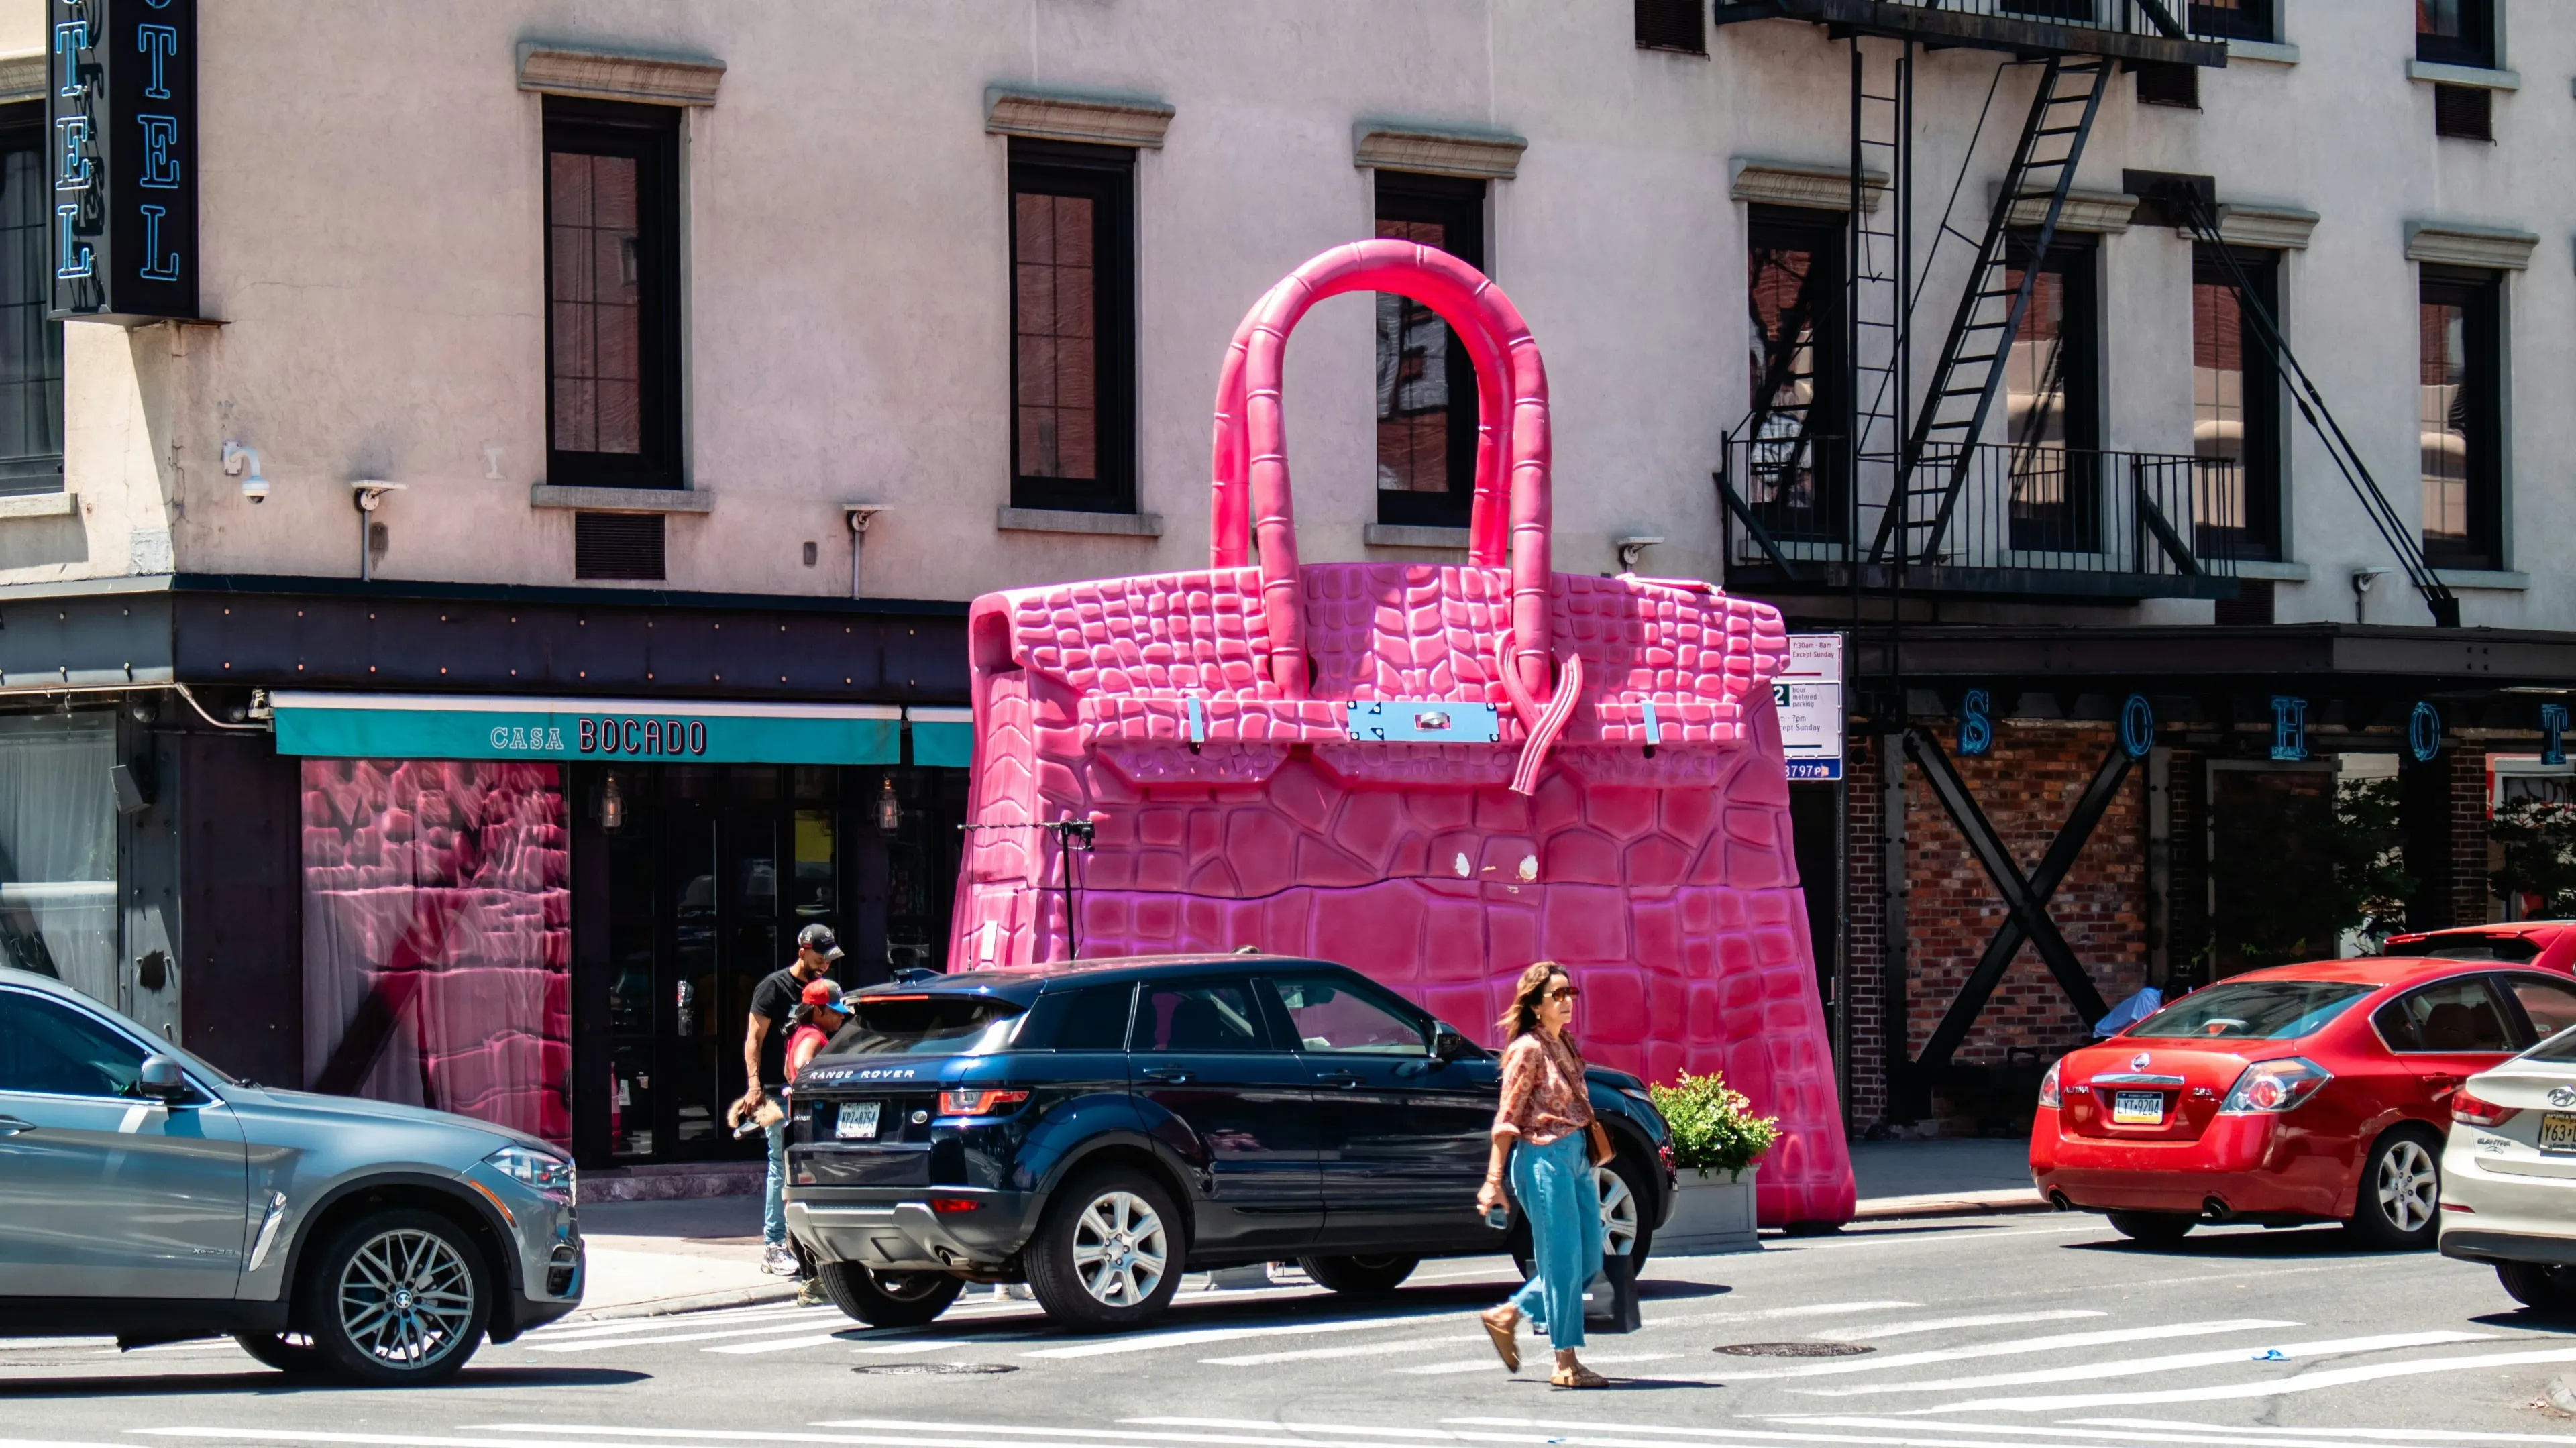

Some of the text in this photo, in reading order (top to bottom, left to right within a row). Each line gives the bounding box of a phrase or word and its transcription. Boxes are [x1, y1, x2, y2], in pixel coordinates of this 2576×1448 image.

[56, 0, 91, 280] TEL
[138, 0, 180, 282] TEL
[1773, 685, 1784, 706] 2
[1792, 714, 1807, 723] 7pm
[490, 717, 707, 755] CASA BOCADO
[1795, 724, 1821, 732] Sunday
[810, 1069, 915, 1080] RANGE ROVER
[2064, 1085, 2090, 1094] ALTIMA
